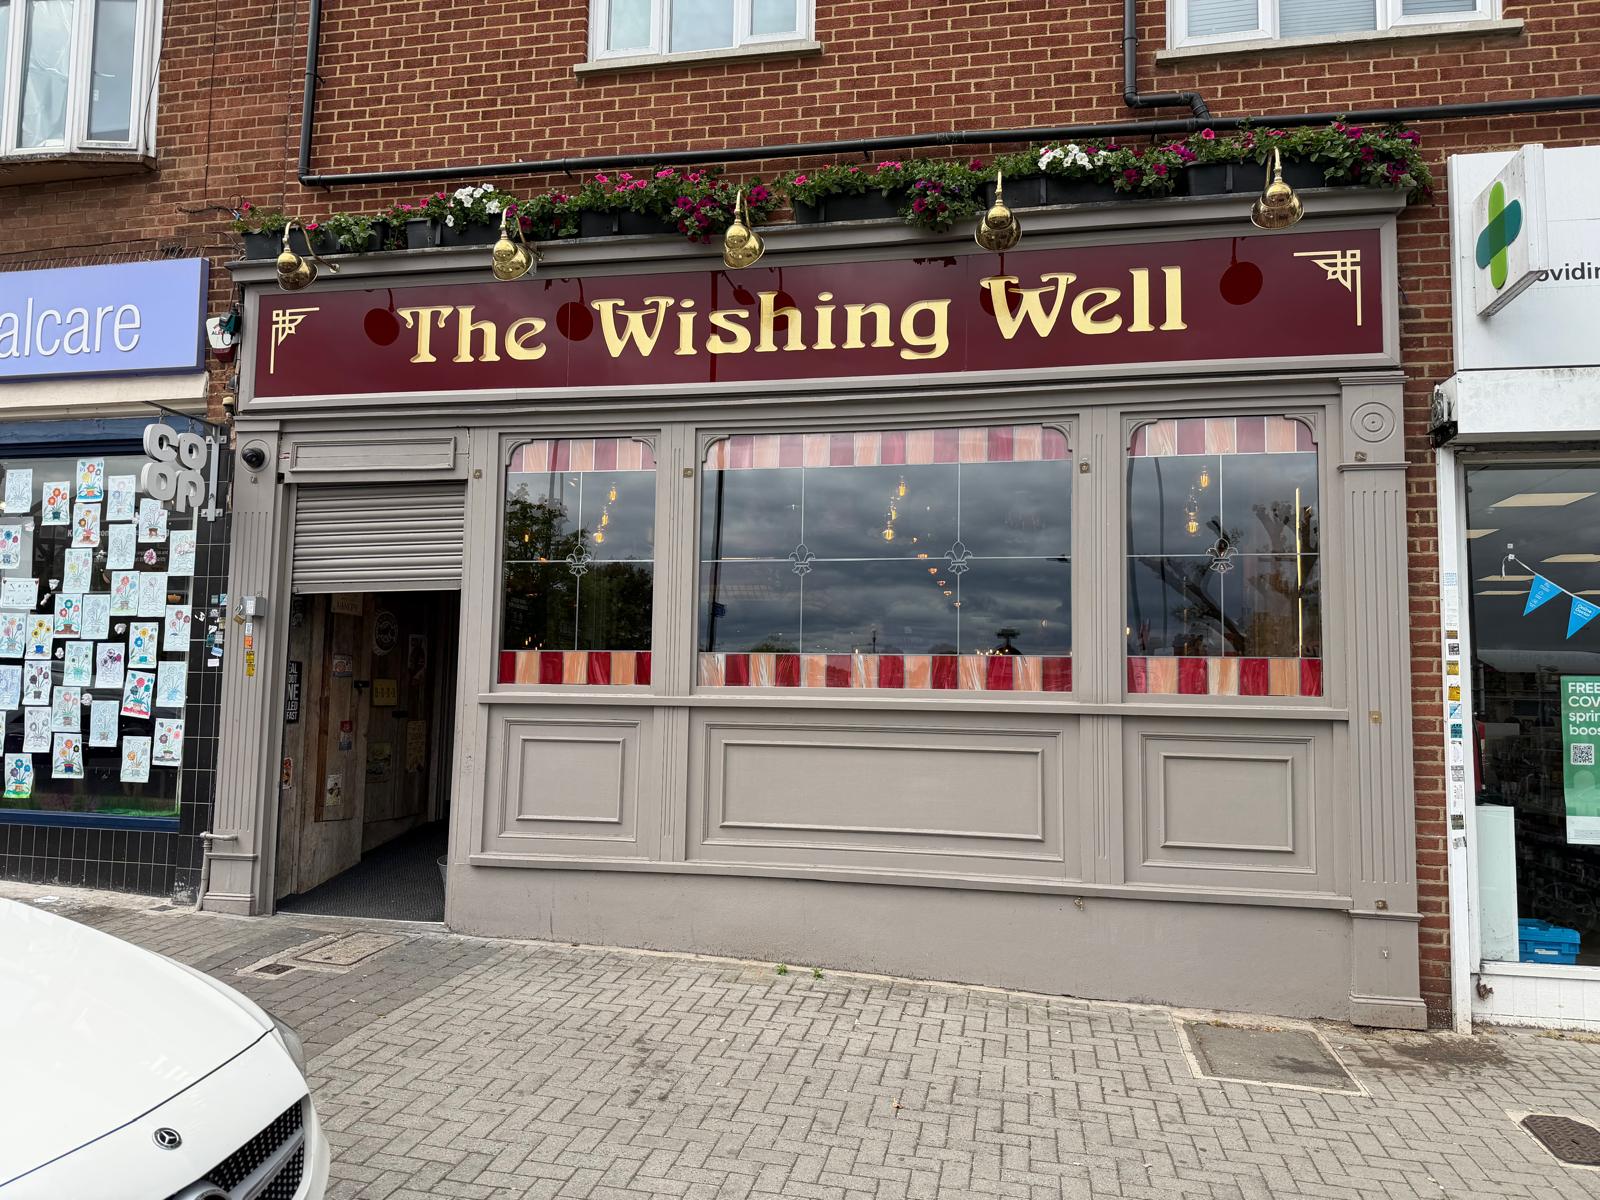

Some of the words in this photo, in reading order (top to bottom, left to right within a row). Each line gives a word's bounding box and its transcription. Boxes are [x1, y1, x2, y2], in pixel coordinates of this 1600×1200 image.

[396, 304, 547, 364] The
[590, 291, 952, 360] Wishing
[979, 265, 1188, 340] Well
[1568, 682, 1600, 693] FREE
